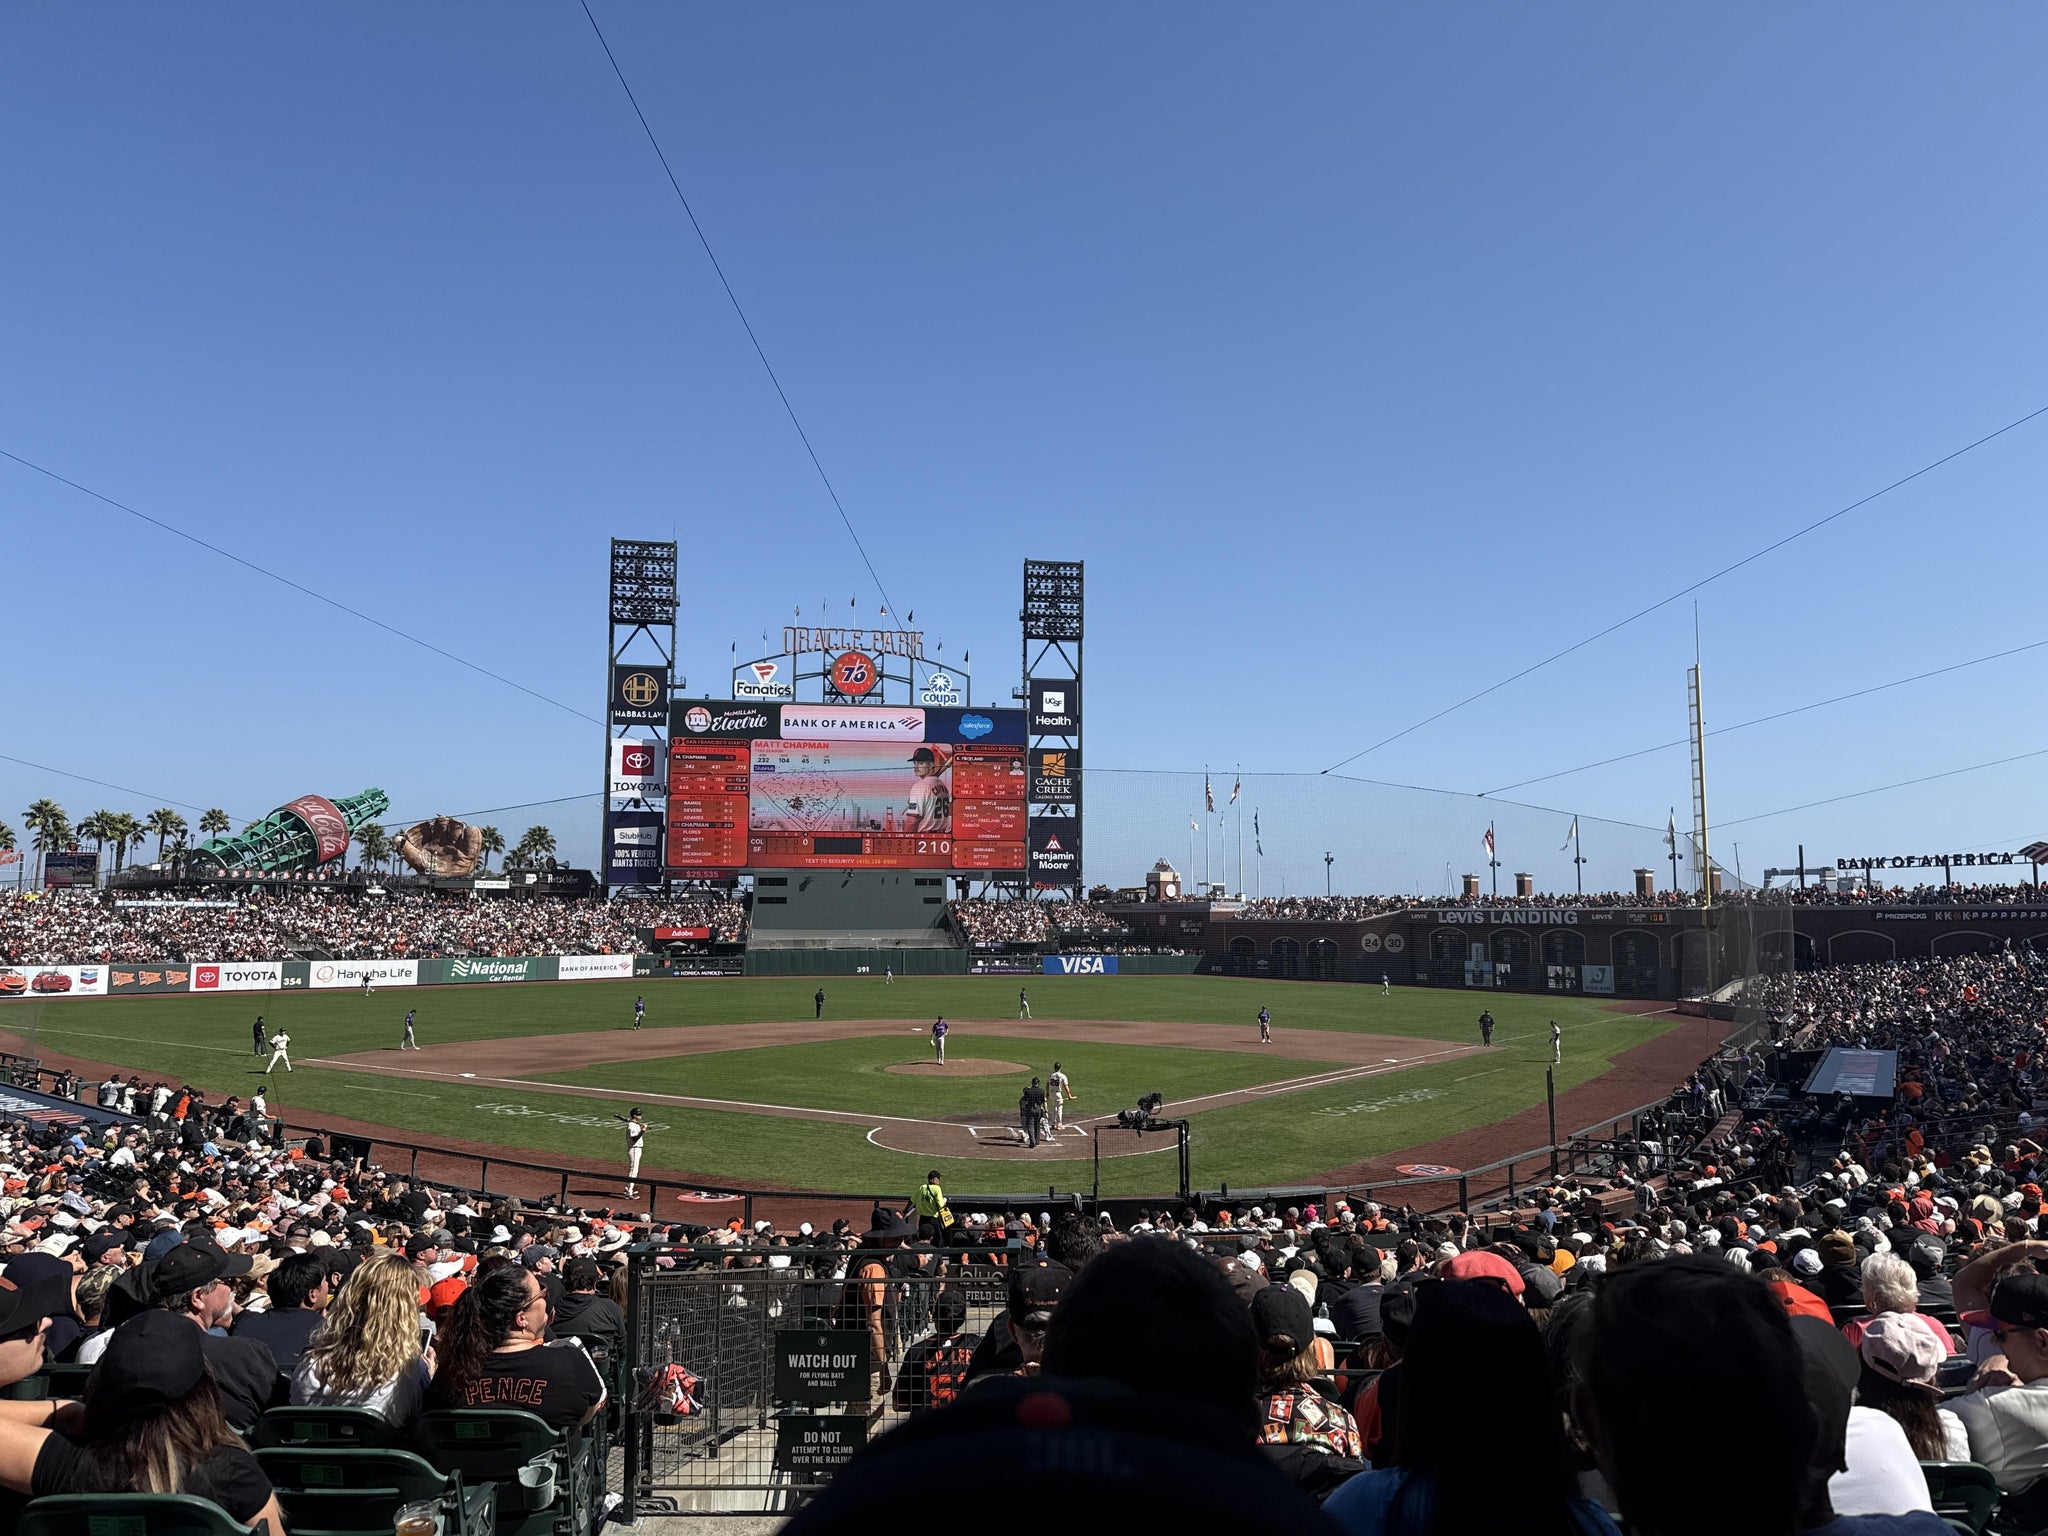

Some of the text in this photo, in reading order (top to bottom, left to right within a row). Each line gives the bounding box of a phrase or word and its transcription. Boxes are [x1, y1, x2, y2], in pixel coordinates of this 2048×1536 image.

[783, 627, 924, 660] ORACLE PARK
[841, 663, 868, 684] 76
[737, 681, 792, 697] Fanatics
[923, 692, 957, 704] coupa
[1044, 697, 1062, 707] UCSF
[615, 710, 665, 719] HABBAS LAW
[711, 714, 768, 732] Electric
[783, 718, 896, 730] BANK OF AMERICA
[1035, 715, 1071, 726] Health
[963, 722, 990, 730] salesforce
[754, 741, 780, 749] MATT
[1035, 777, 1072, 786] CACHE
[613, 782, 661, 792] TOYOTA
[1036, 786, 1071, 794] CREEK
[934, 797, 950, 819] 26
[619, 831, 652, 840] StubHub
[614, 850, 656, 858] 100% VERIFIED
[1033, 851, 1074, 861] Benjamin
[612, 858, 658, 868] GIANTS TICKETS
[1038, 860, 1068, 869] Moore
[1837, 852, 2014, 870] BANK OF AMERICA
[1490, 911, 1578, 925] LANDING
[671, 929, 694, 937] Adobe
[1365, 938, 1379, 948] 24
[1387, 938, 1401, 948] 30
[470, 961, 528, 974] National
[1058, 957, 1105, 974] VISA
[224, 971, 277, 982] TOYOTA
[337, 968, 412, 979] Hanwha Life
[1416, 973, 1428, 981] 365
[283, 977, 302, 985] 354
[960, 1267, 1004, 1285] blue
[966, 1290, 992, 1300] FIELD
[788, 1354, 857, 1369] WATCH OUT
[465, 1377, 548, 1406] PENCE
[804, 1431, 841, 1443] DO NOT
[791, 1446, 854, 1454] ATTEMPT TO CLIMB
[792, 1455, 810, 1464] OVER
[811, 1455, 825, 1464] THE
